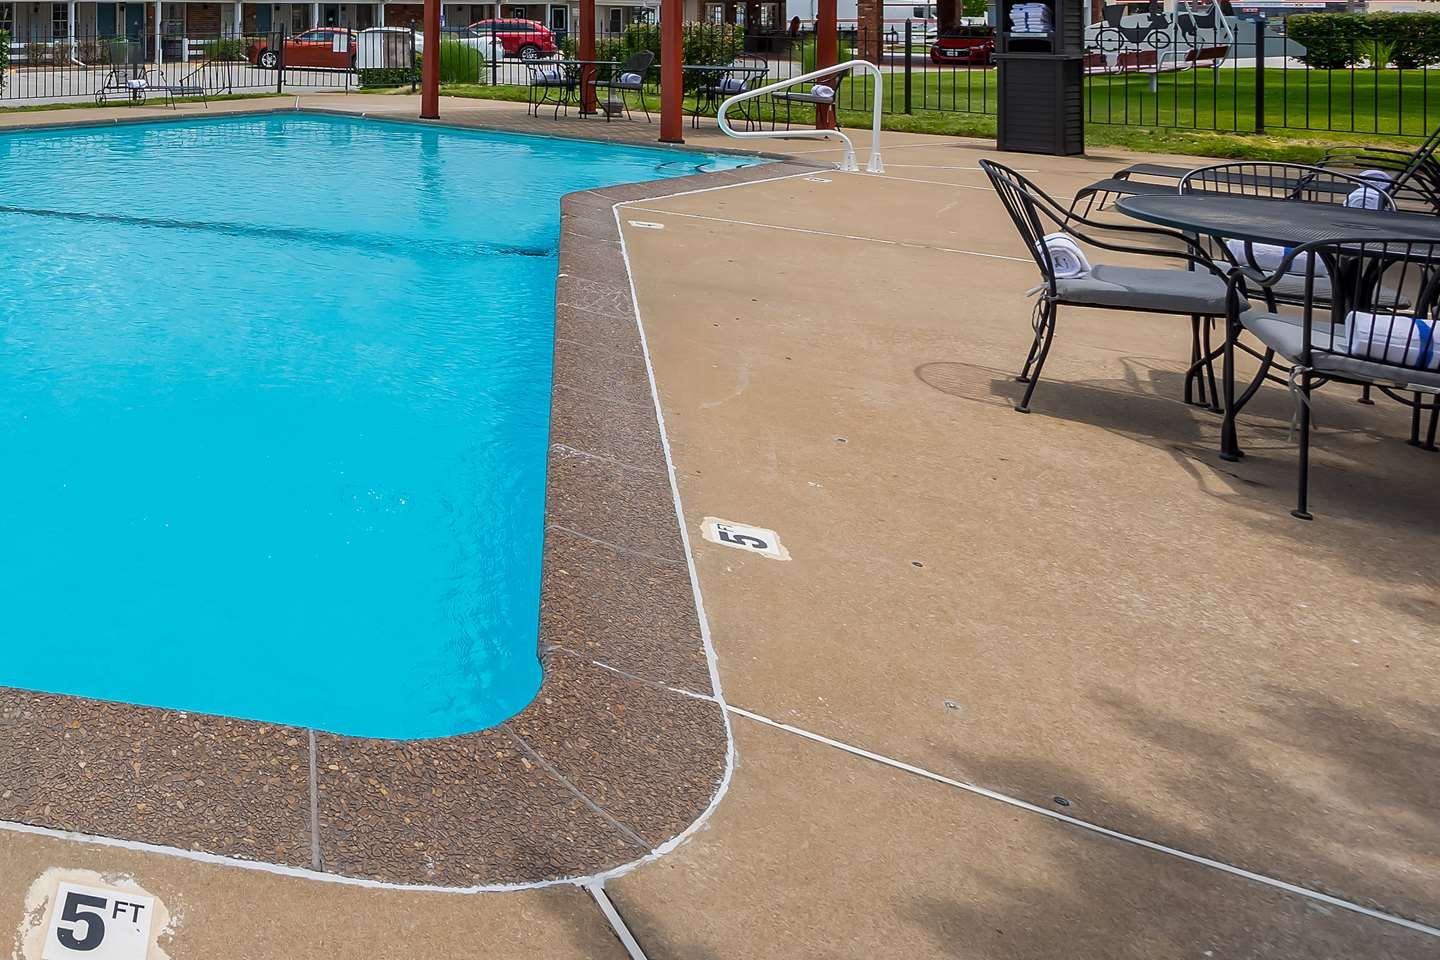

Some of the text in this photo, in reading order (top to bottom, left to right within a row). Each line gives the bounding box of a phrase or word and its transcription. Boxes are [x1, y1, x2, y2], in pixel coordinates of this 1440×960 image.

[718, 530, 768, 549] 5
[56, 891, 145, 952] 5 FT
